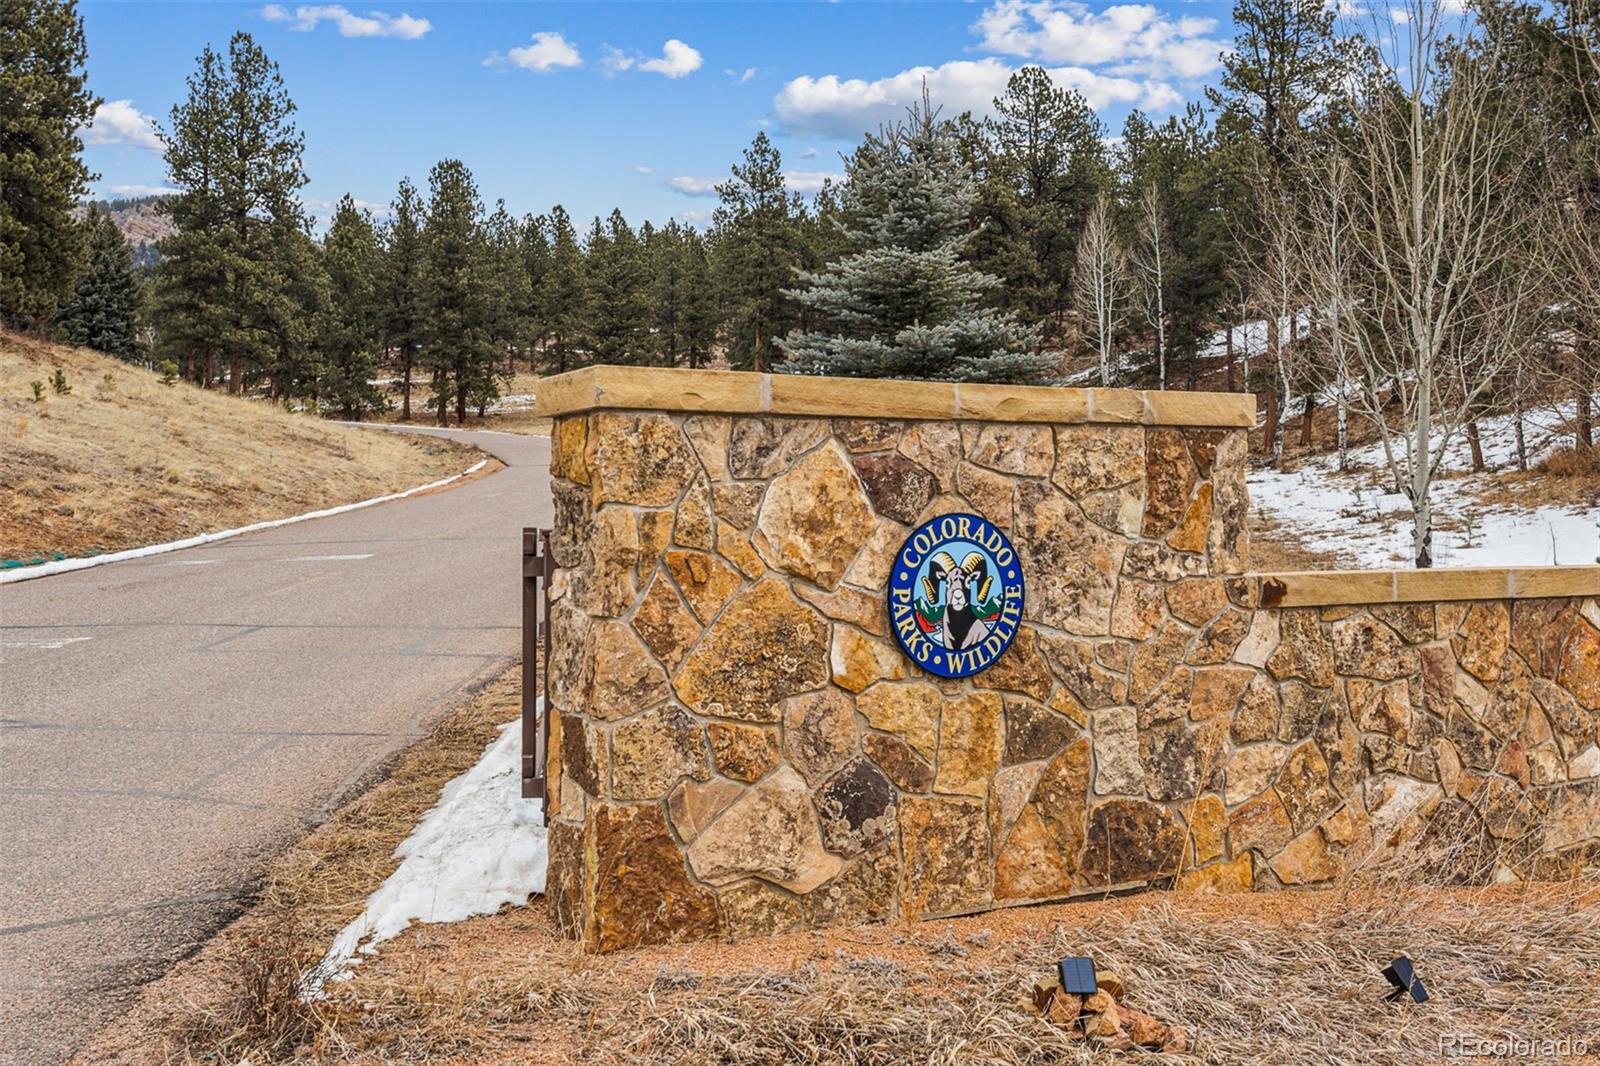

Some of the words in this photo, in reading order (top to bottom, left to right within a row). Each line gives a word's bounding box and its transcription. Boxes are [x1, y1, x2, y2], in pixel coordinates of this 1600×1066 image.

[902, 517, 1013, 569] COLORADO
[893, 587, 933, 662] PARKS
[946, 584, 1021, 673] WILDLIFE
